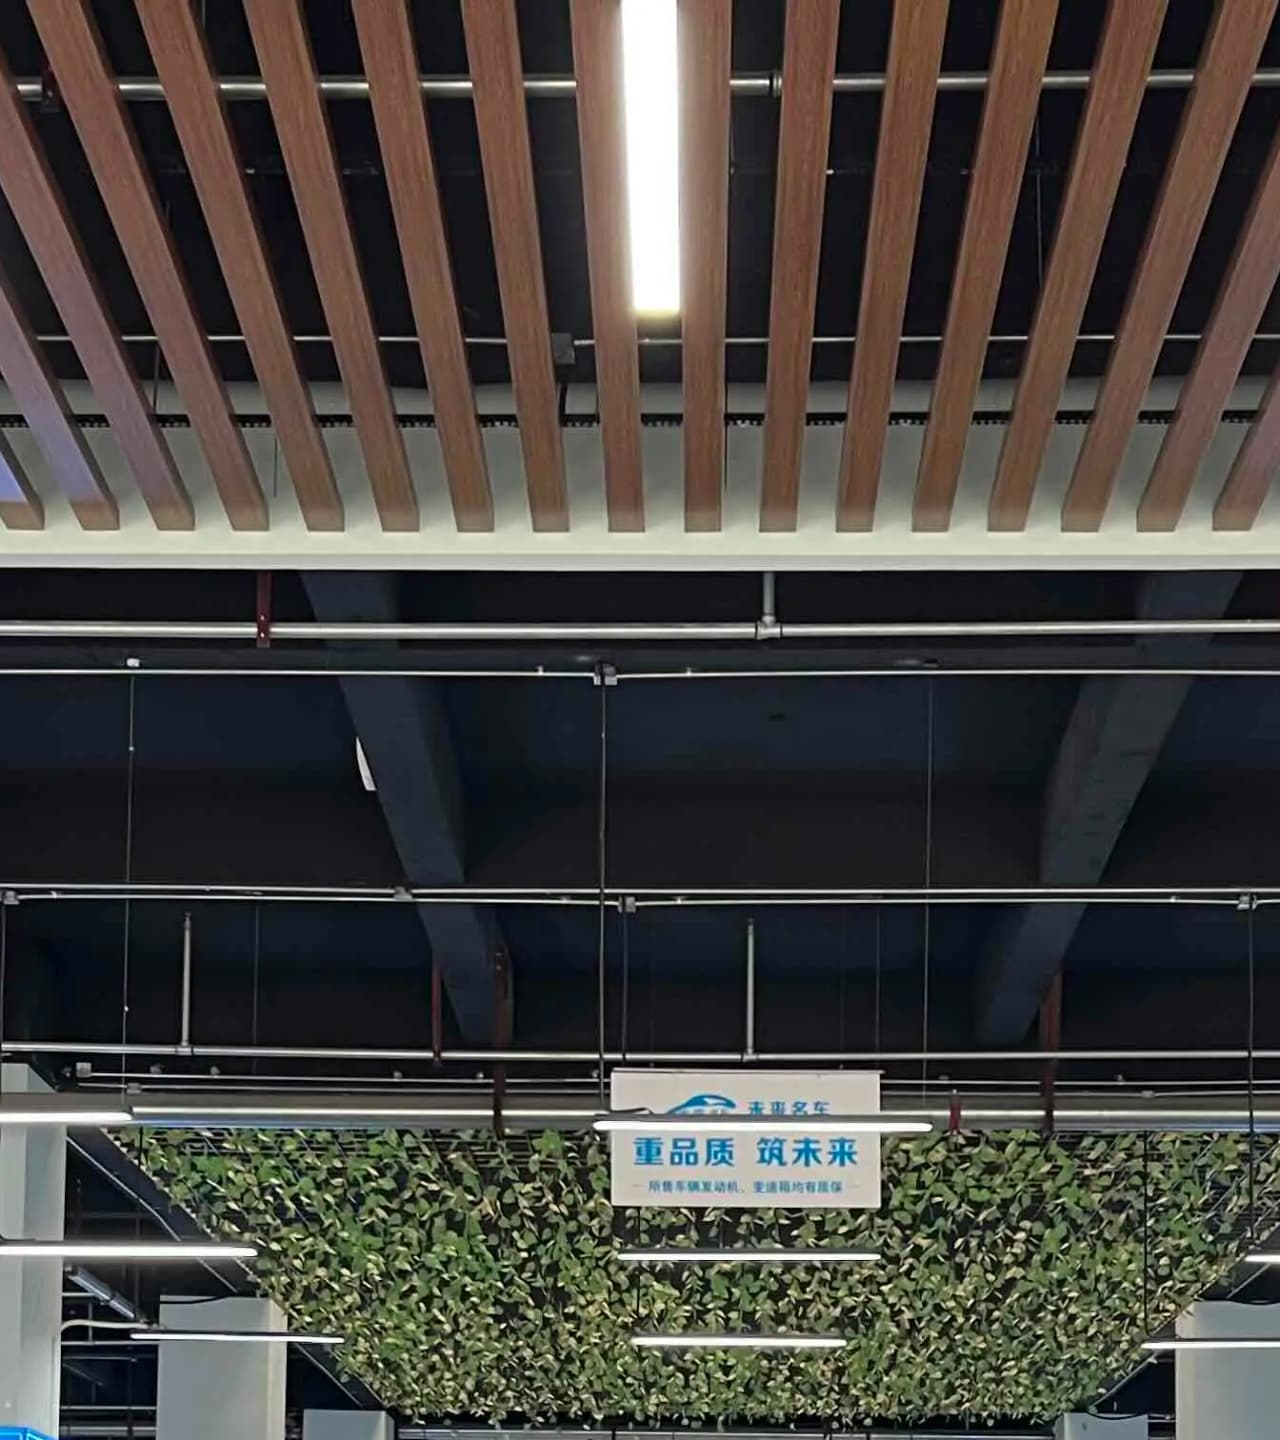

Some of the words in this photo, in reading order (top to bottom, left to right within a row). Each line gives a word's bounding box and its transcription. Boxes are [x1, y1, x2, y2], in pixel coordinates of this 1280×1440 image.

[634, 1137, 734, 1167] 重品质
[756, 1136, 858, 1167] 筑未来
